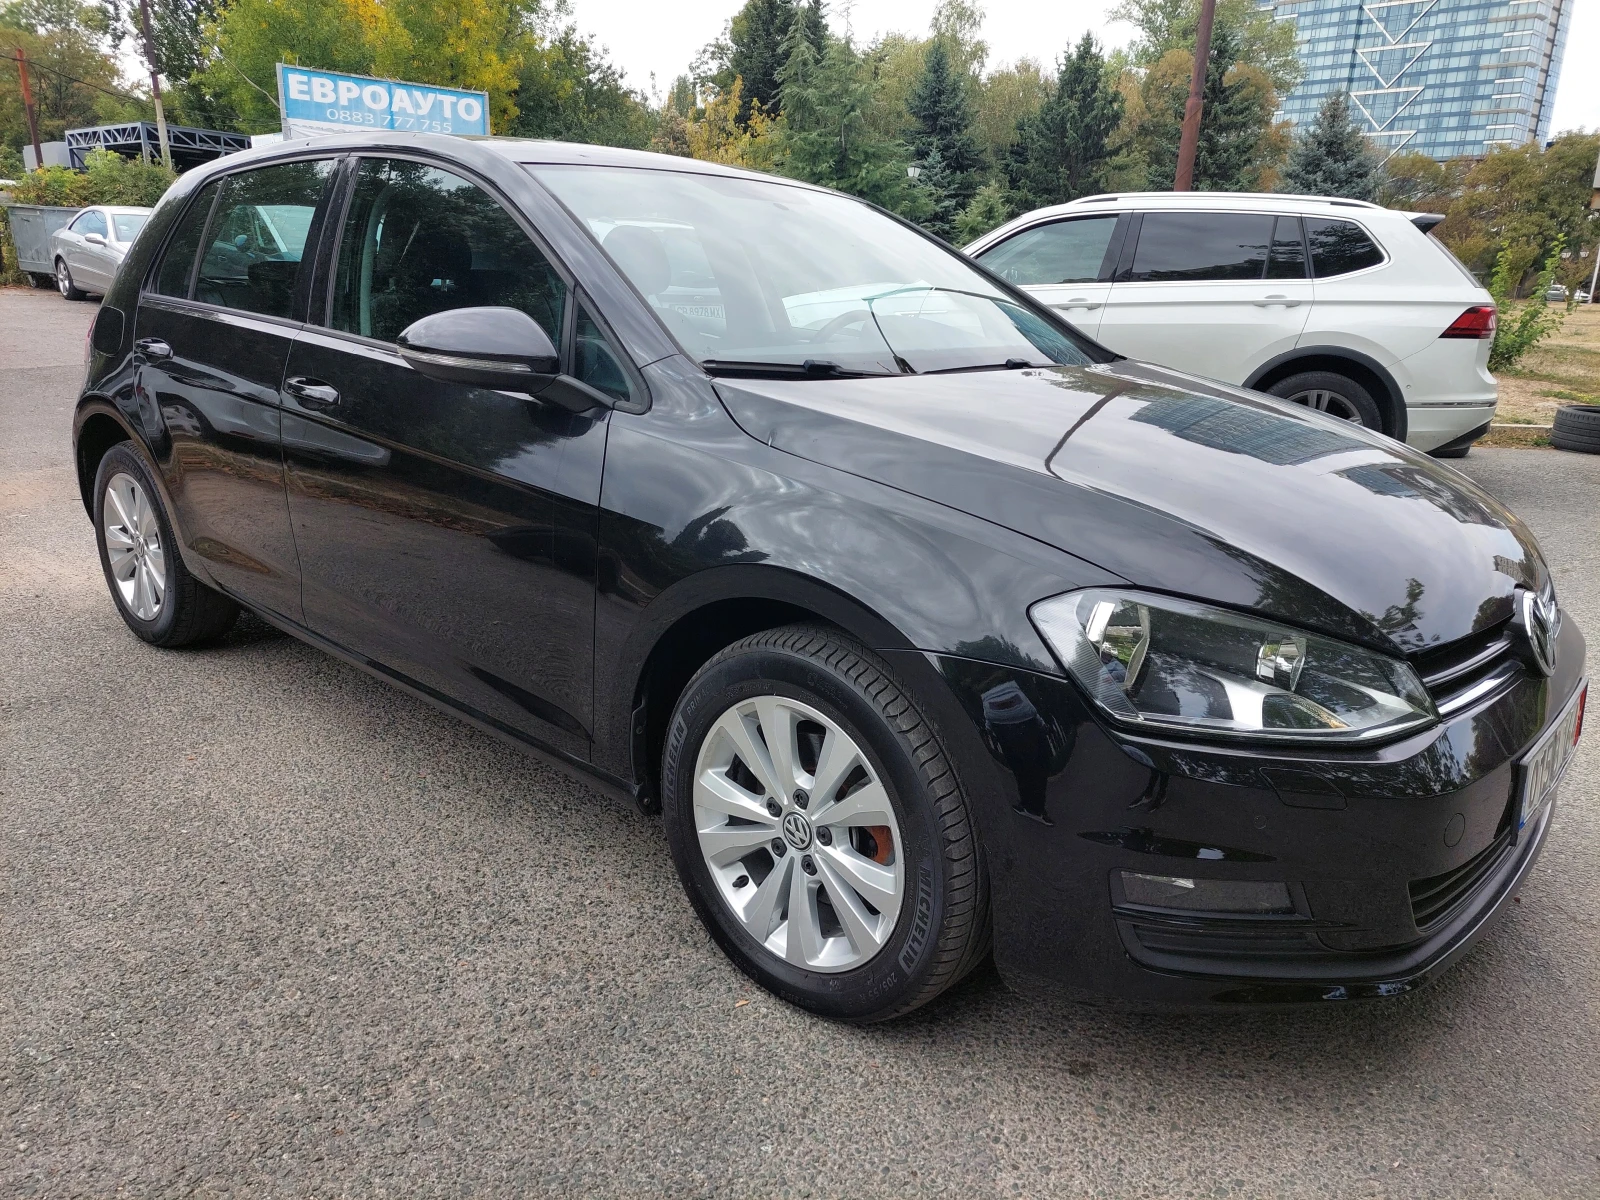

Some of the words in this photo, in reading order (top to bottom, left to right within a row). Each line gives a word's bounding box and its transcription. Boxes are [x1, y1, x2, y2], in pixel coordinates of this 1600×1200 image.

[287, 73, 482, 122] ЕВРОАУТО
[326, 108, 374, 124] 0883
[381, 115, 415, 128] 777
[421, 119, 452, 133] 755
[666, 720, 685, 813] MICHELIN
[901, 865, 932, 970] MICHELIN
